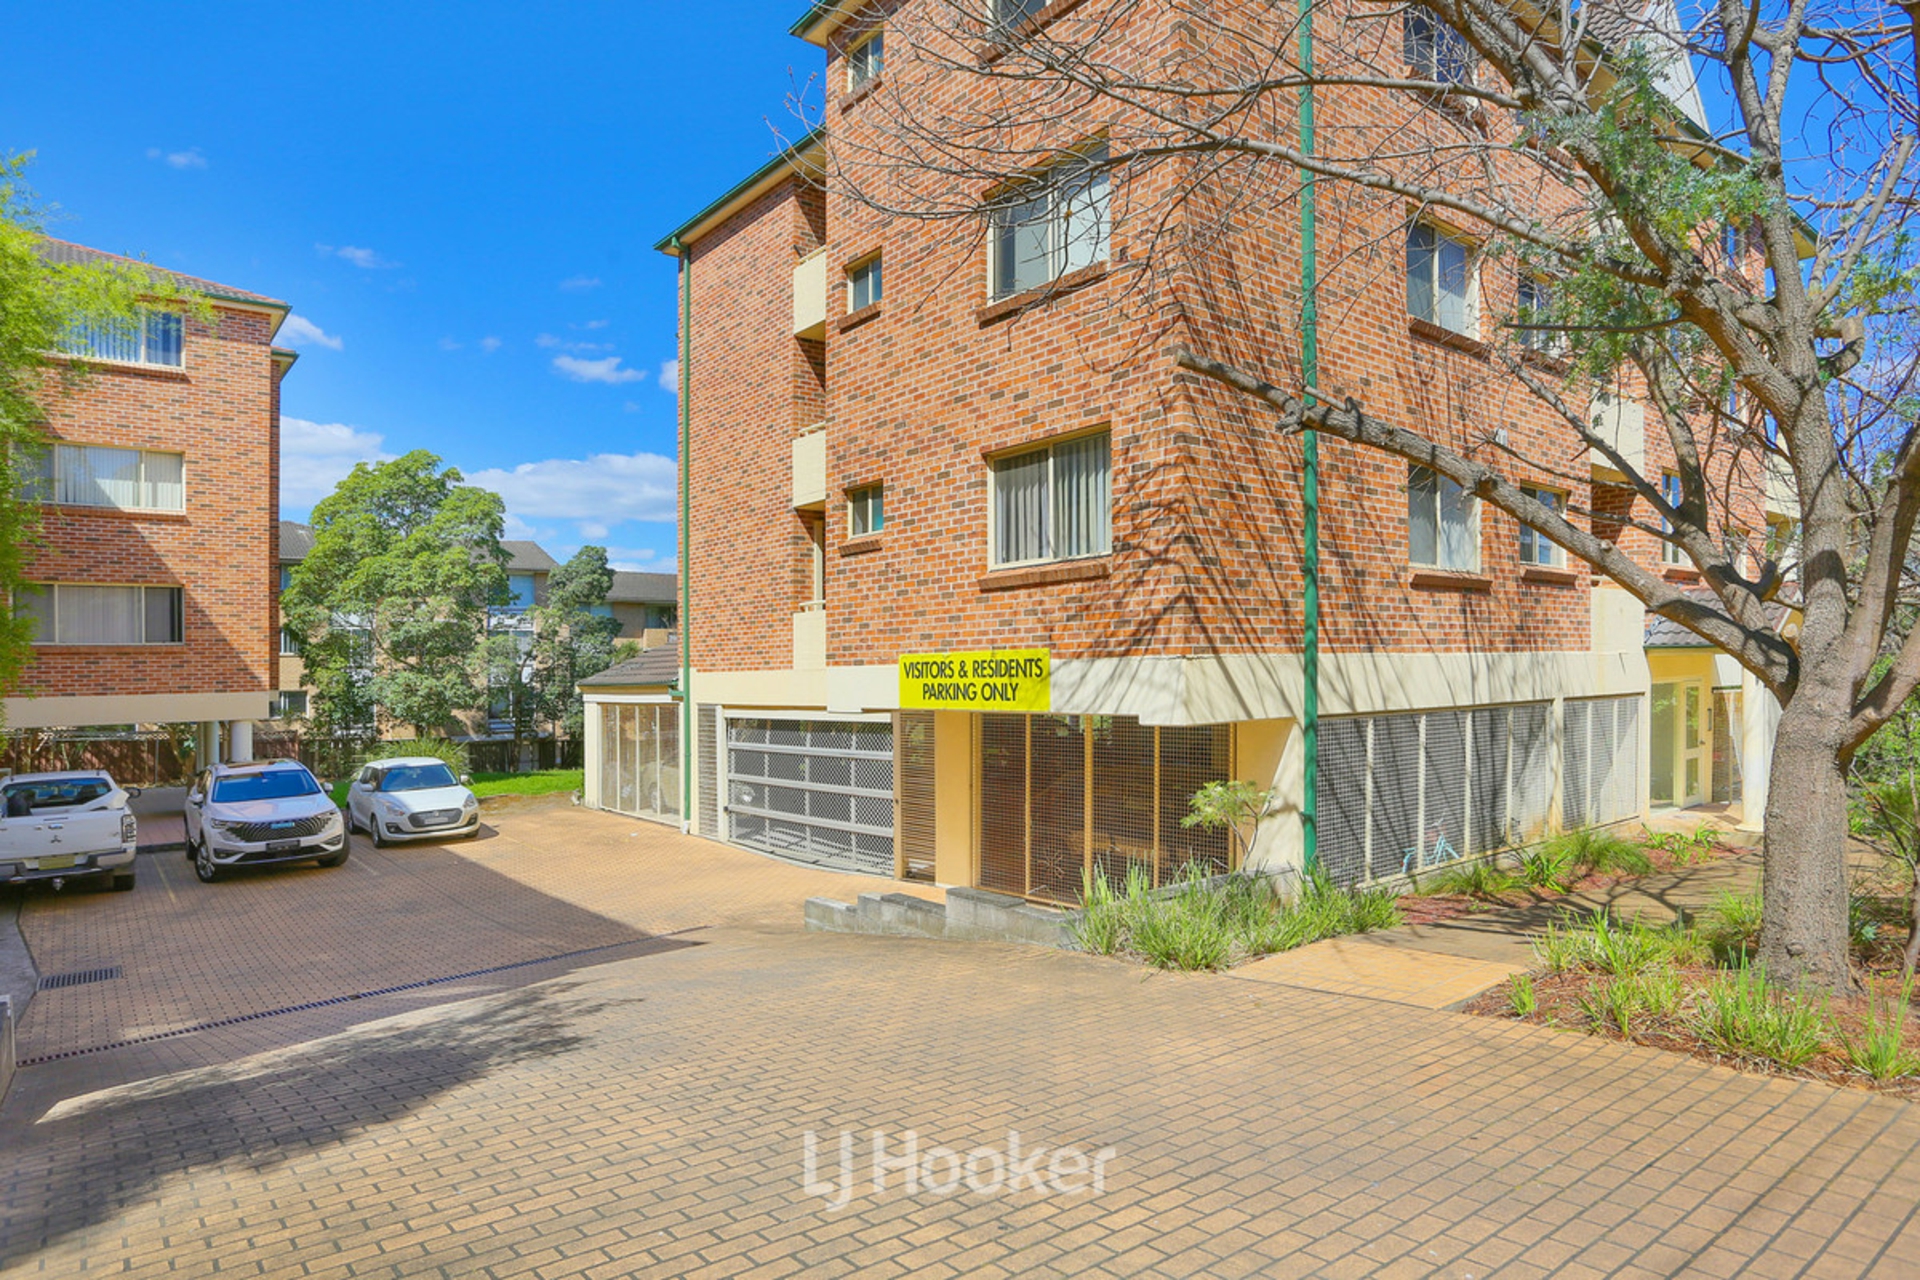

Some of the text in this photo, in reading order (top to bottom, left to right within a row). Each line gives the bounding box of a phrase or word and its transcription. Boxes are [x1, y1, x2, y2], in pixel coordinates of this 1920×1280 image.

[903, 657, 1044, 679] VISITORS & RESIDENTS
[922, 682, 1020, 702] PARKING ONLY
